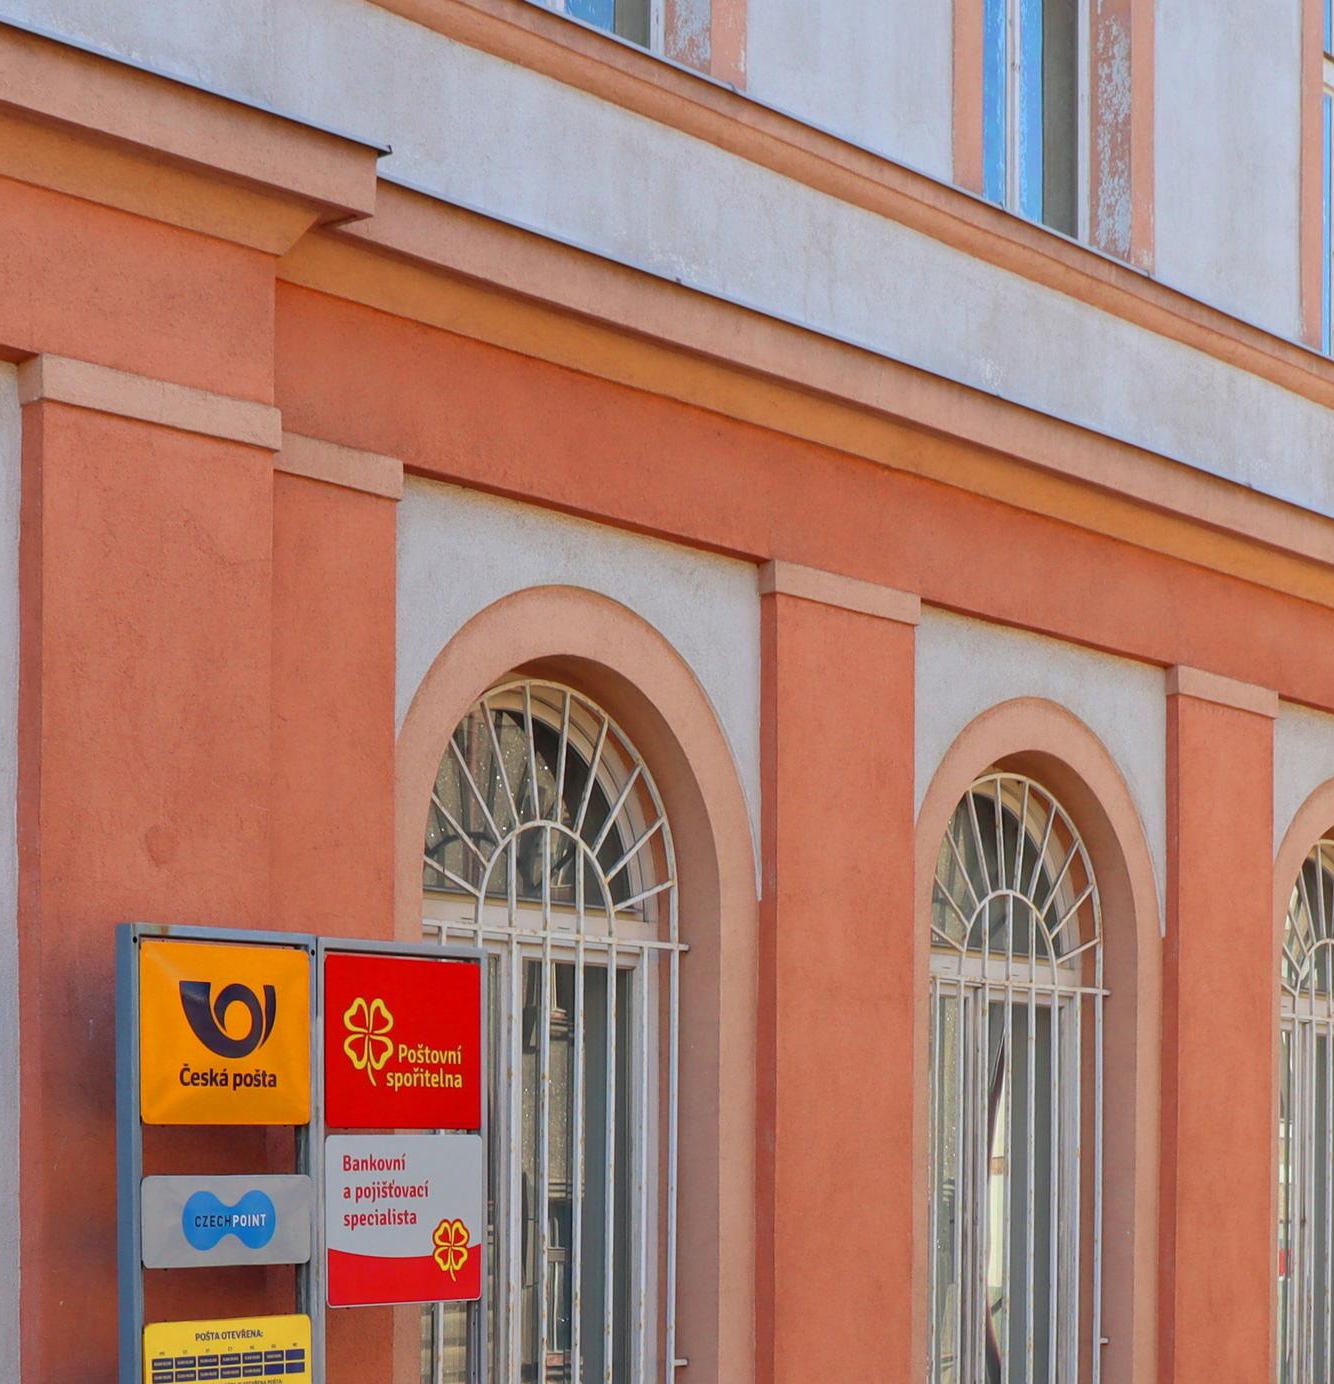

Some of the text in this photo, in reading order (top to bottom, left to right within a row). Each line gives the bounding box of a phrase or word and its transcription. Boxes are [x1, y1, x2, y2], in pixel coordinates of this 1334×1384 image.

[398, 1043, 462, 1065] Poštovní
[179, 1063, 277, 1091] Česká pošta
[386, 1067, 463, 1092] spořitelna
[342, 1153, 406, 1172] Bankovní
[343, 1179, 429, 1204] a pojišťovací
[343, 1208, 417, 1231] specialista
[195, 1331, 220, 1342] POŠTA
